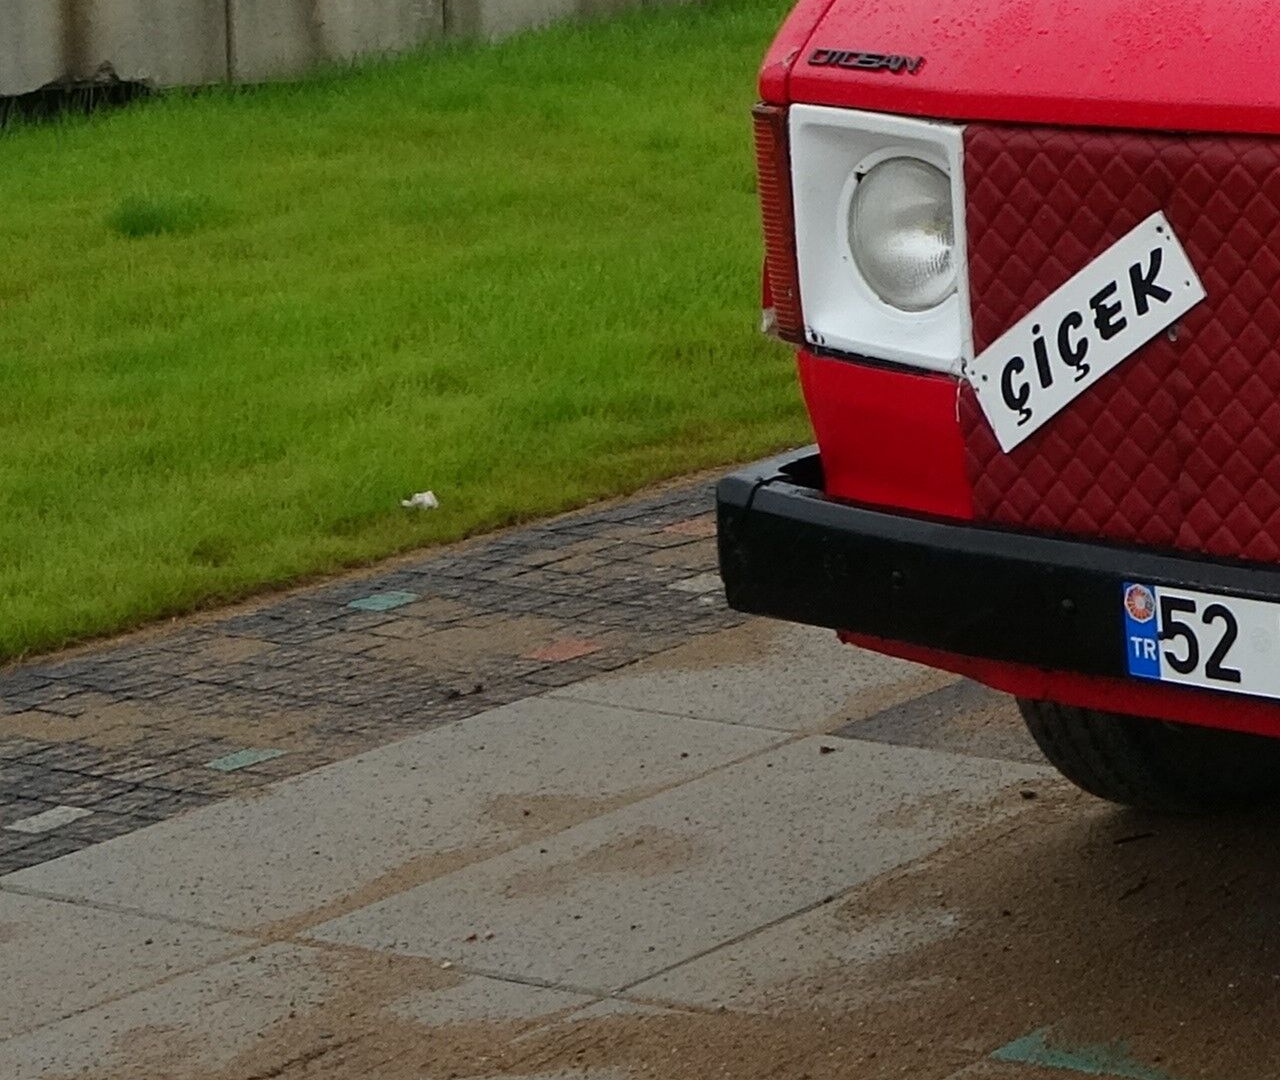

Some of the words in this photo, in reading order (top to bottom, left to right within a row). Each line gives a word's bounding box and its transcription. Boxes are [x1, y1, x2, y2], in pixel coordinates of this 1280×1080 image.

[1001, 247, 1172, 426] ÇİÇEK
[1130, 635, 1157, 661] TR
[1158, 594, 1241, 684] 52
